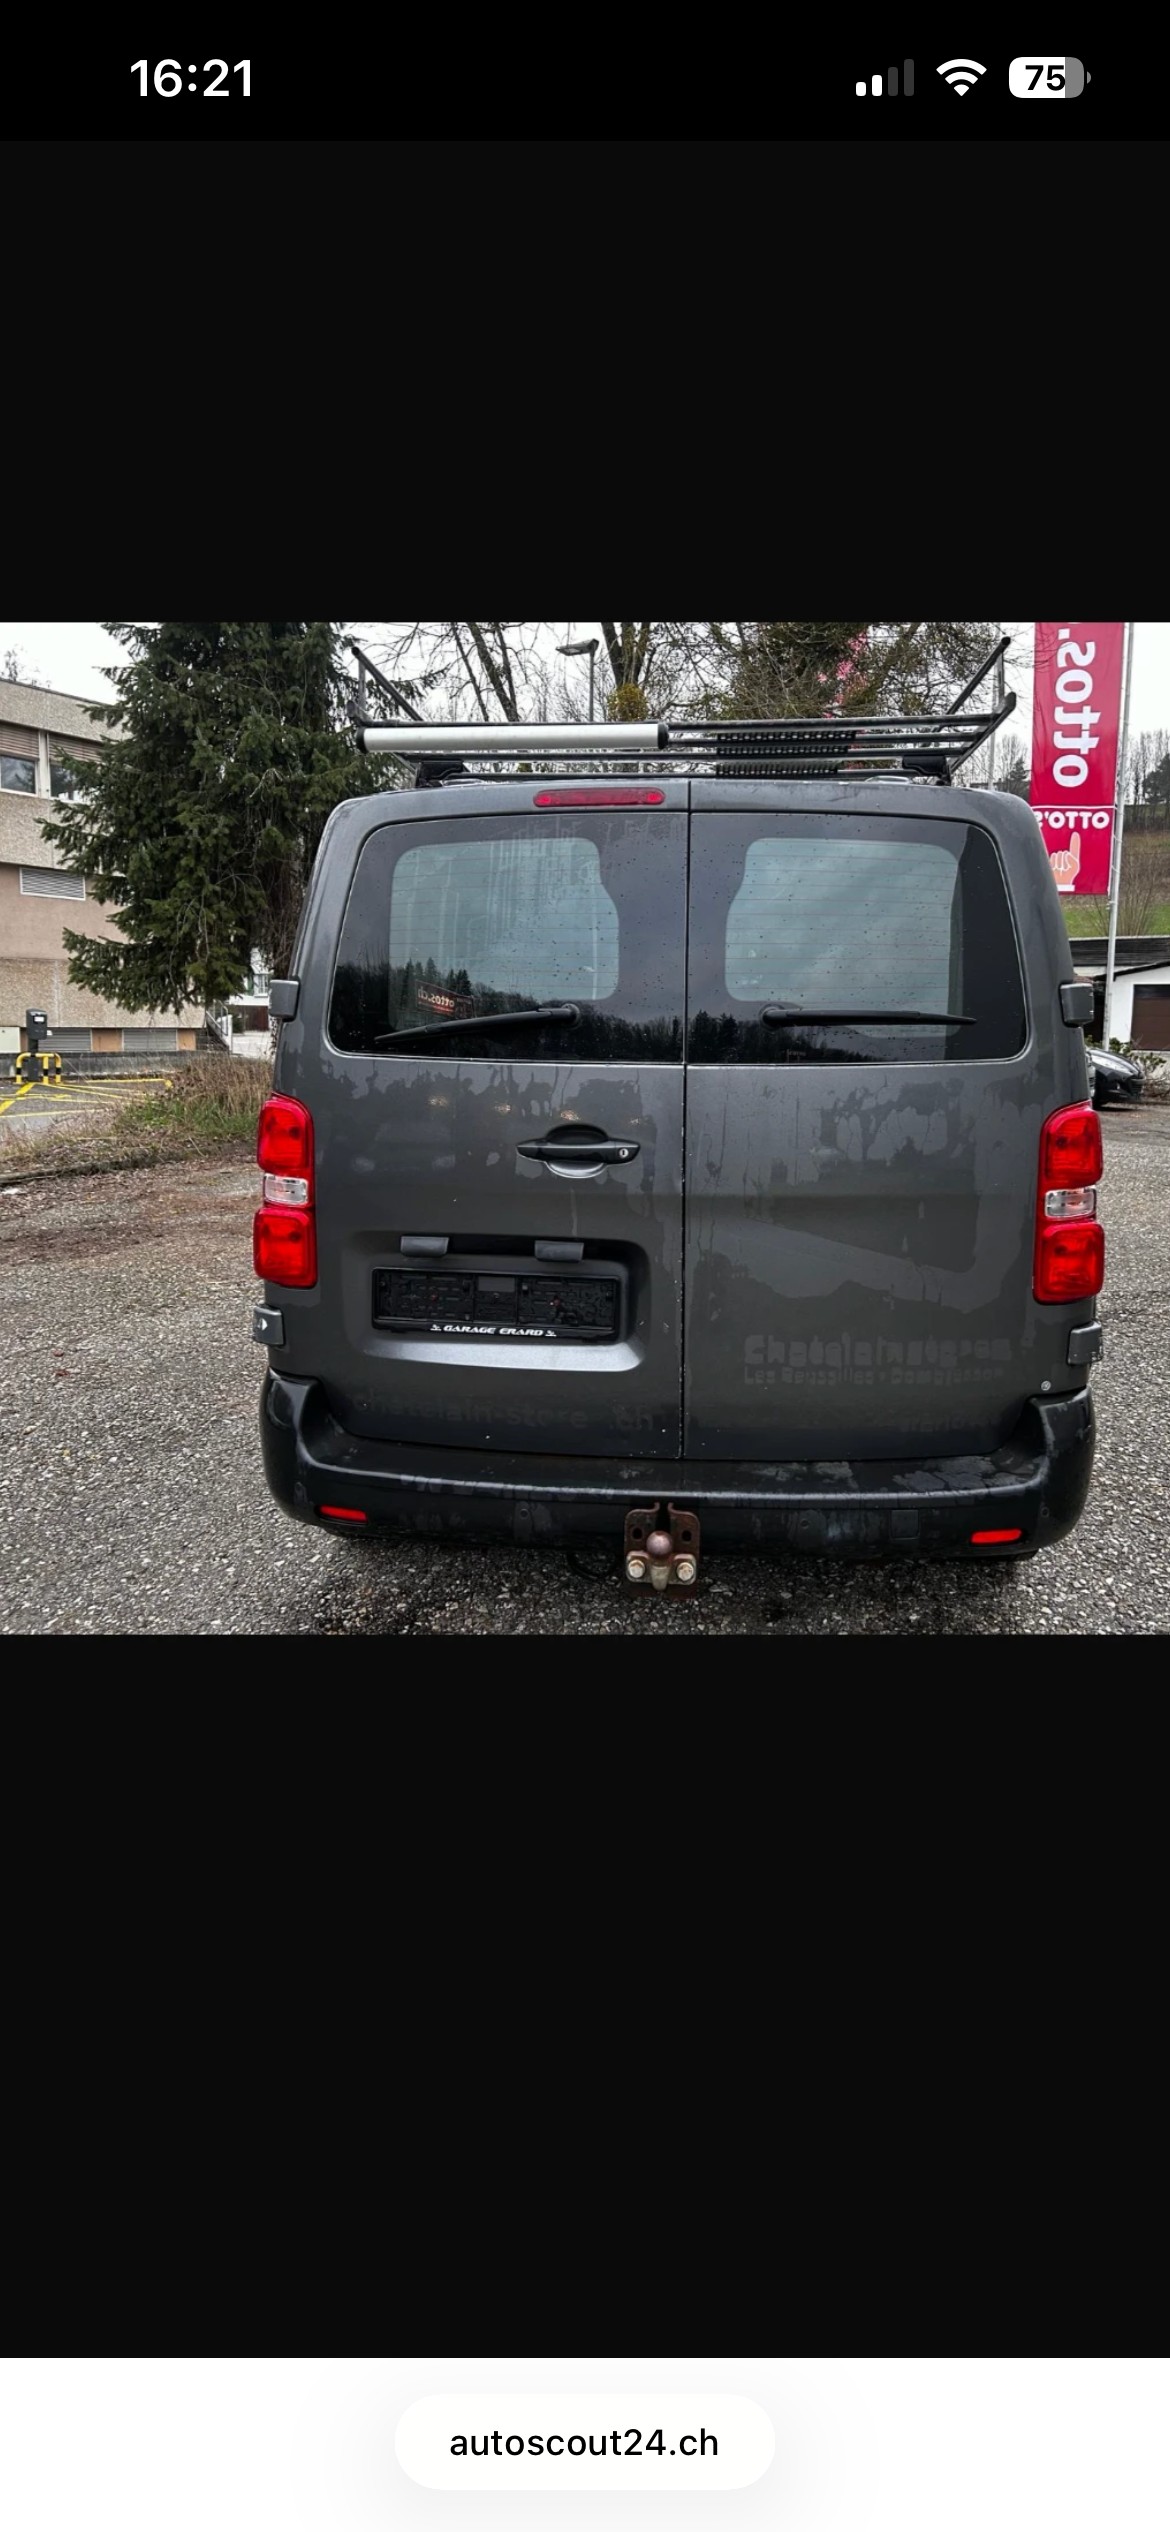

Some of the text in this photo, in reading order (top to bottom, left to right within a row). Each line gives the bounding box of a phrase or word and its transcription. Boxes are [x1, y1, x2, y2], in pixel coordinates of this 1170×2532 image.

[443, 1324, 544, 1336] GARAGE ERARD
[744, 1366, 776, 1385] Les
